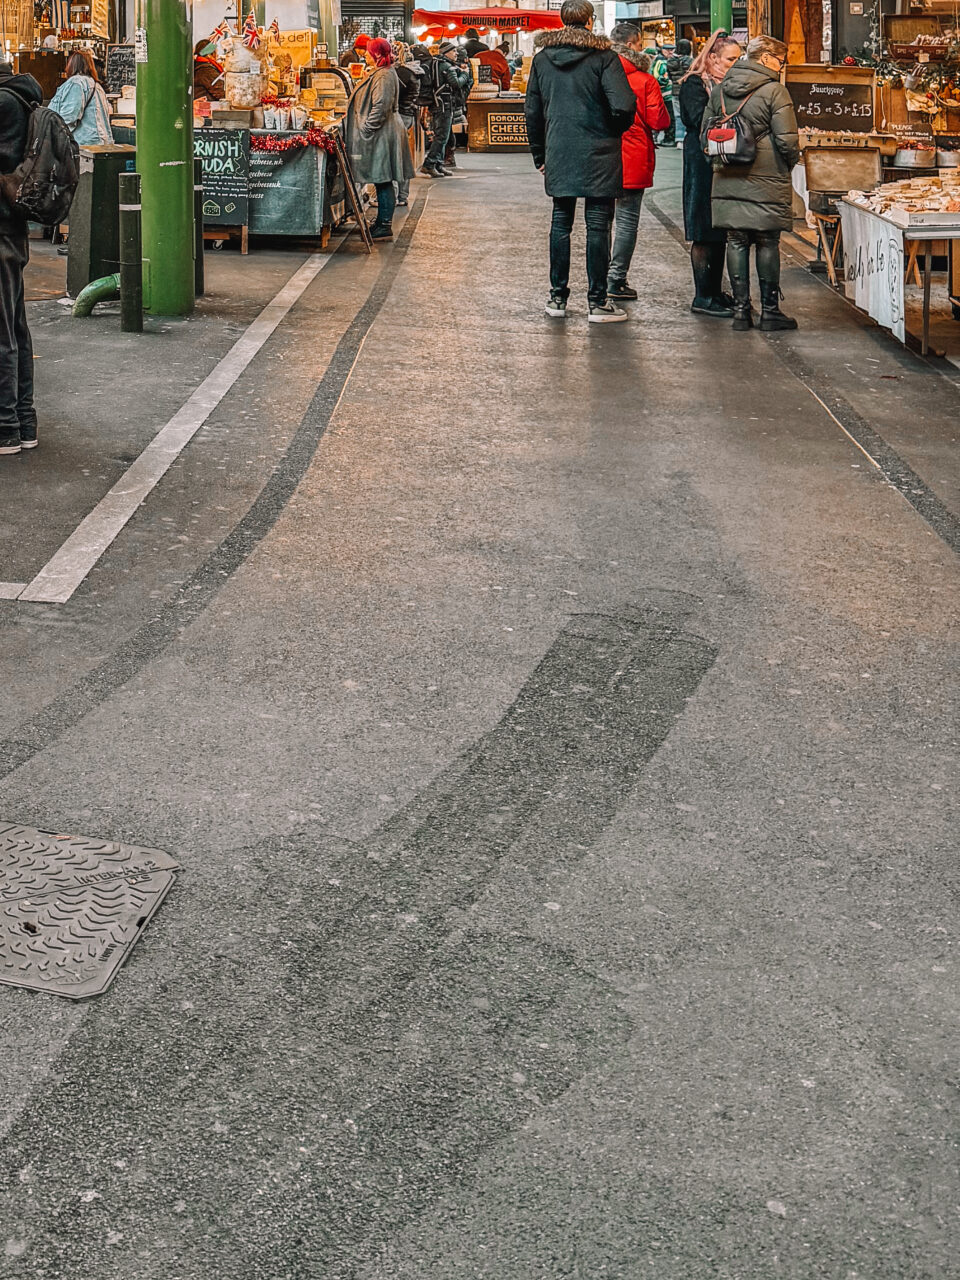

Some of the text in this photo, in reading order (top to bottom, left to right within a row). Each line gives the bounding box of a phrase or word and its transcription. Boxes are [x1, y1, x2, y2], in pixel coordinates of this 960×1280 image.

[462, 15, 530, 27] BOROUGH MARKET
[806, 103, 821, 115] £5
[834, 103, 843, 115] 3
[202, 158, 235, 173] UDA
